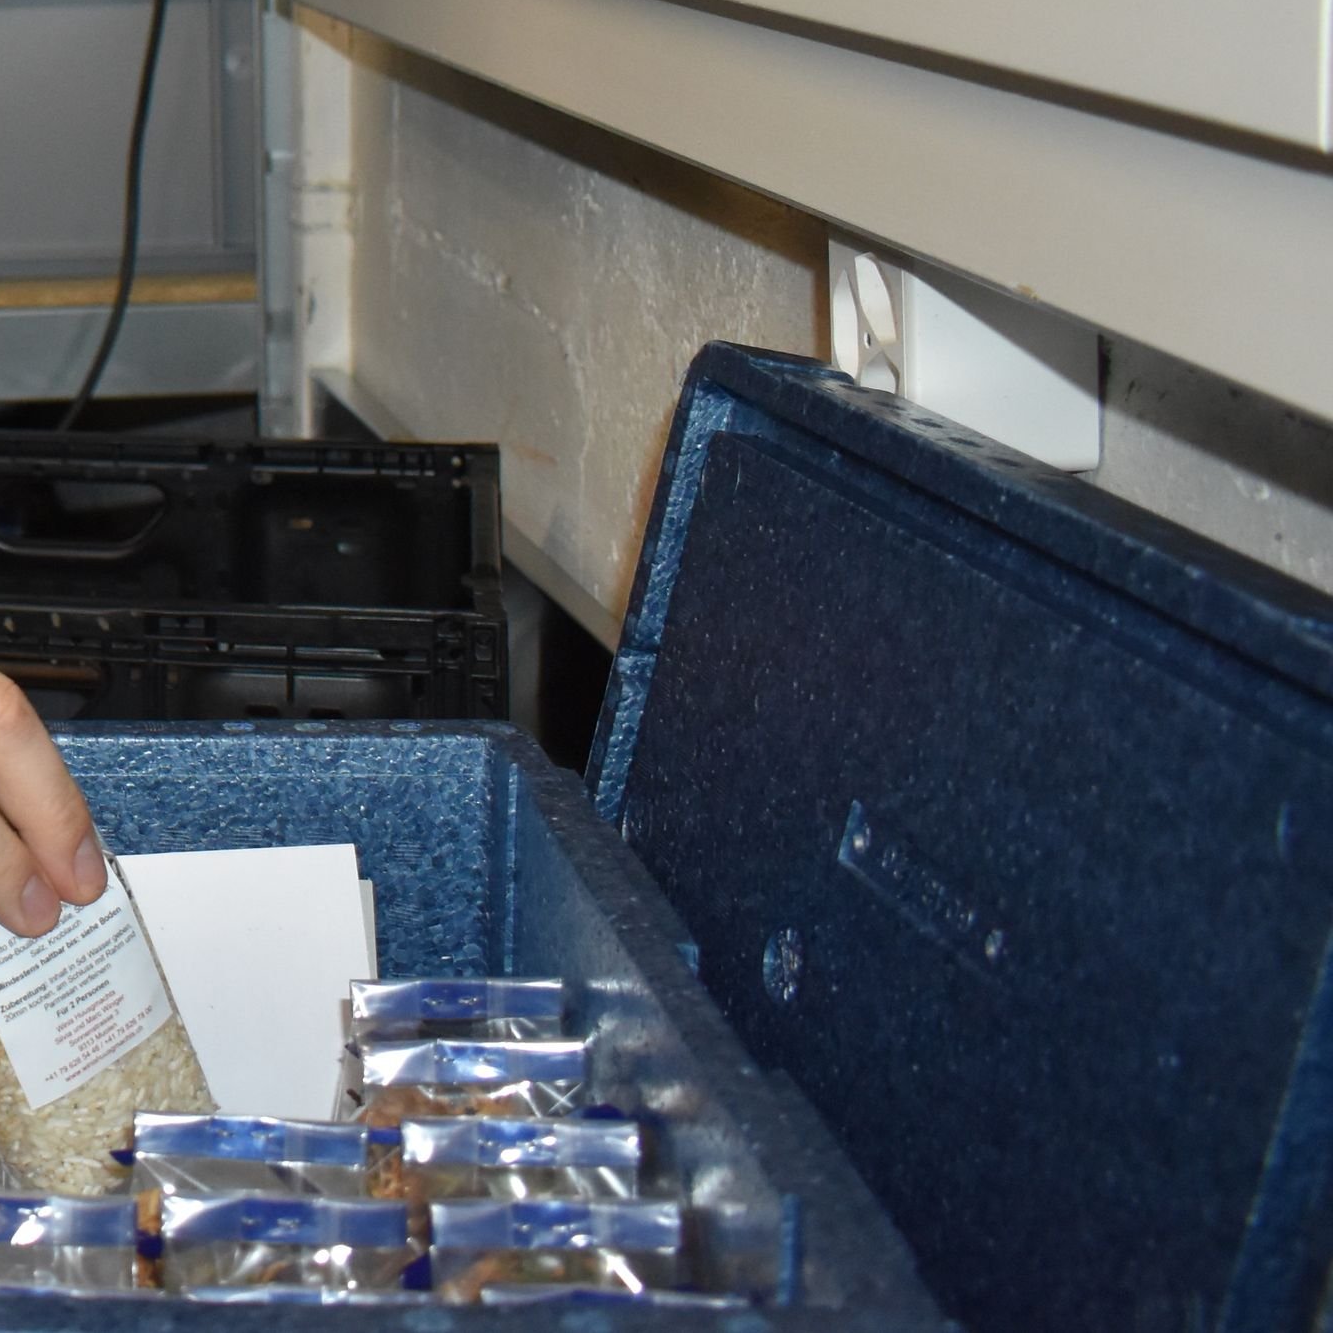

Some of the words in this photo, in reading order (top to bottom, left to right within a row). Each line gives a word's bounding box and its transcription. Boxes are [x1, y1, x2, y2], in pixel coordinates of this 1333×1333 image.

[39, 945, 65, 965] haltbar
[65, 935, 80, 948] bis:
[79, 921, 99, 938] siehe
[98, 904, 122, 925] Boden
[46, 918, 82, 946] Knoblauch
[2, 1004, 28, 1022] 20min
[55, 979, 67, 991] am
[66, 961, 94, 983] Schluss
[93, 953, 105, 965] mit
[104, 938, 125, 957] Rahm
[123, 929, 136, 943] und
[48, 966, 67, 984] Inhalt
[67, 961, 75, 971] in
[86, 937, 112, 958] Wasser
[42, 983, 78, 1011] Parmesan
[54, 1003, 69, 1017] Für
[68, 1000, 76, 1009] 2
[74, 978, 110, 1004] Personen
[72, 1020, 85, 1033] und
[84, 1010, 101, 1024] Marc
